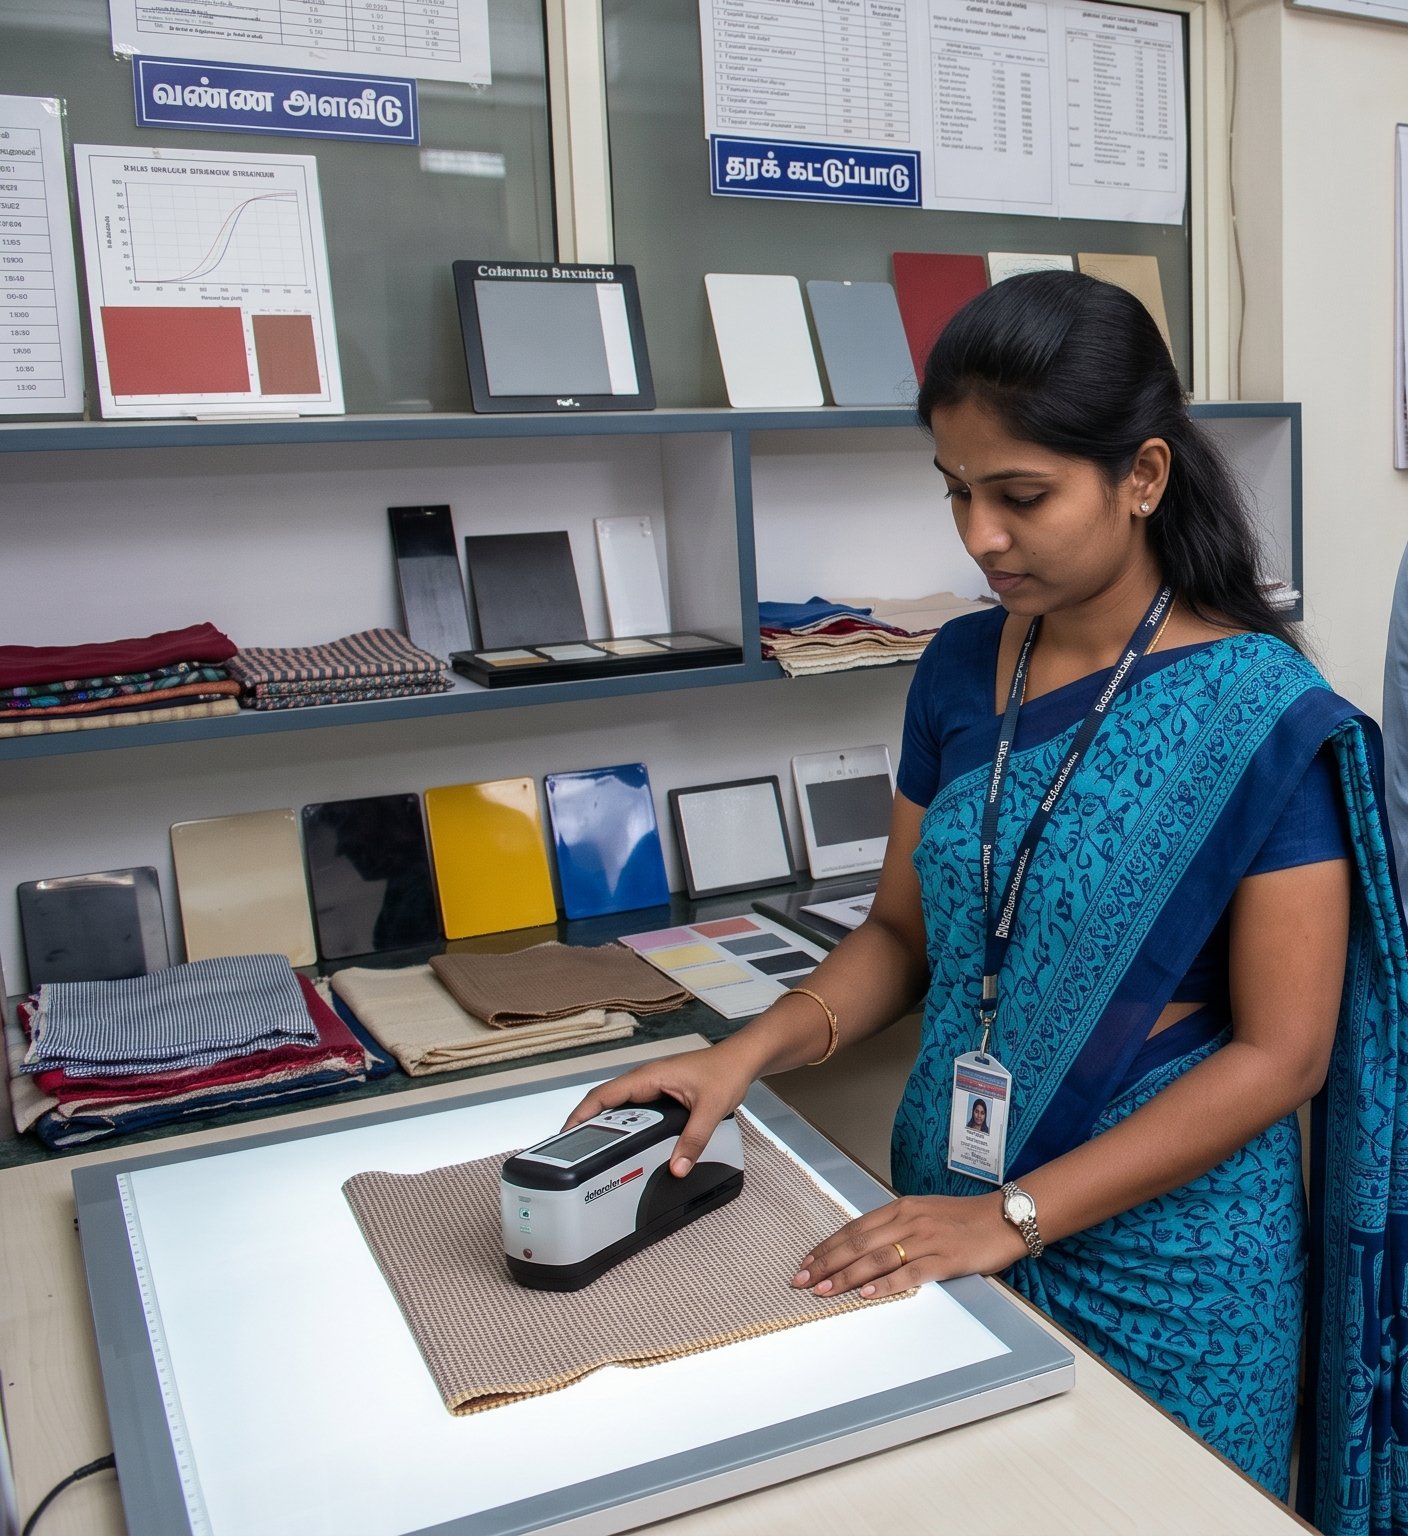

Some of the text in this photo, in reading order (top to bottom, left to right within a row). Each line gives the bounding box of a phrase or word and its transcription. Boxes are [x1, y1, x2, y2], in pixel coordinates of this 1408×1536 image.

[152, 76, 404, 127] வண்ண அளவீடு
[725, 151, 910, 192] தரக் கட்டுப்பாடு
